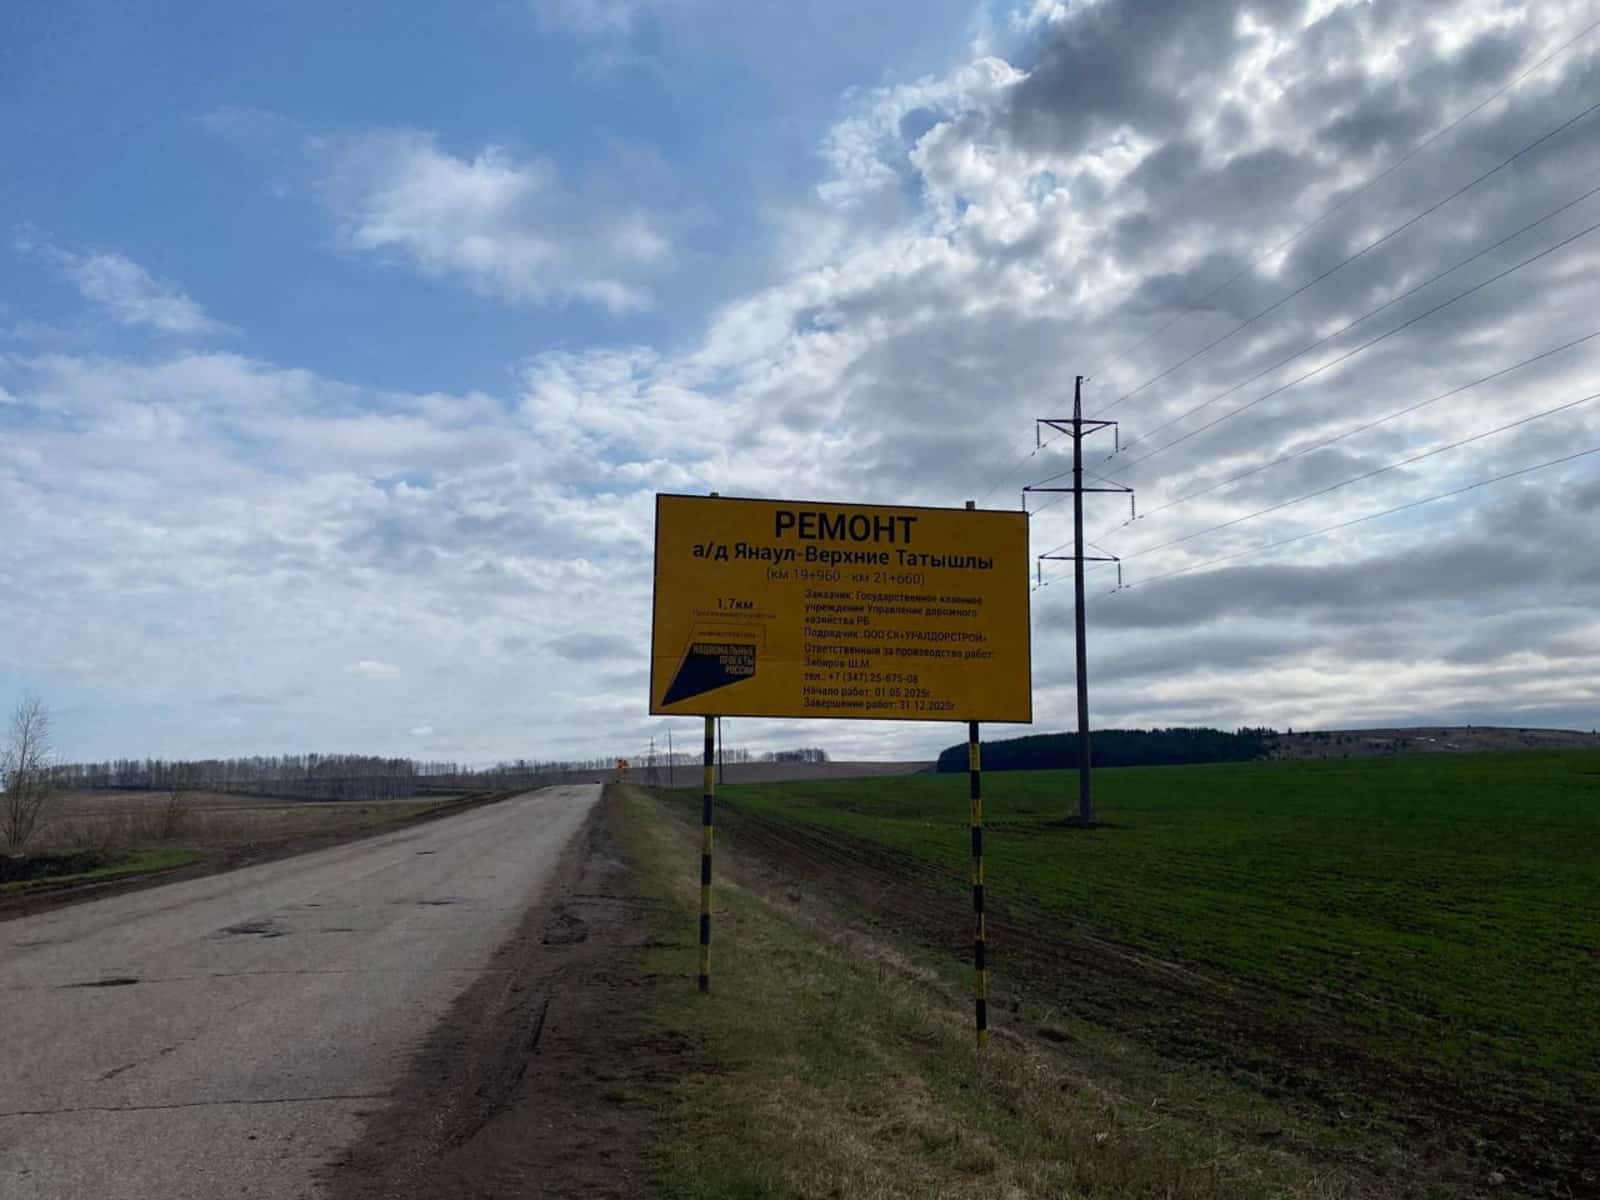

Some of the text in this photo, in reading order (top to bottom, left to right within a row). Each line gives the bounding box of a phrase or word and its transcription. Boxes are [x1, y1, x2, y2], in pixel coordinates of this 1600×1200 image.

[775, 510, 918, 543] РЕМОНТ
[692, 541, 993, 569] а/д Янаул-Верхние Татышлы
[766, 568, 790, 581] (км
[794, 568, 840, 582] 19+960
[852, 573, 869, 583] км
[873, 572, 925, 585] 21+660)
[717, 597, 753, 610] 1,7км
[925, 606, 977, 618] дорожного
[864, 630, 884, 640] ООО
[883, 647, 893, 656] за
[829, 672, 841, 681] +7
[803, 685, 839, 697] Начало
